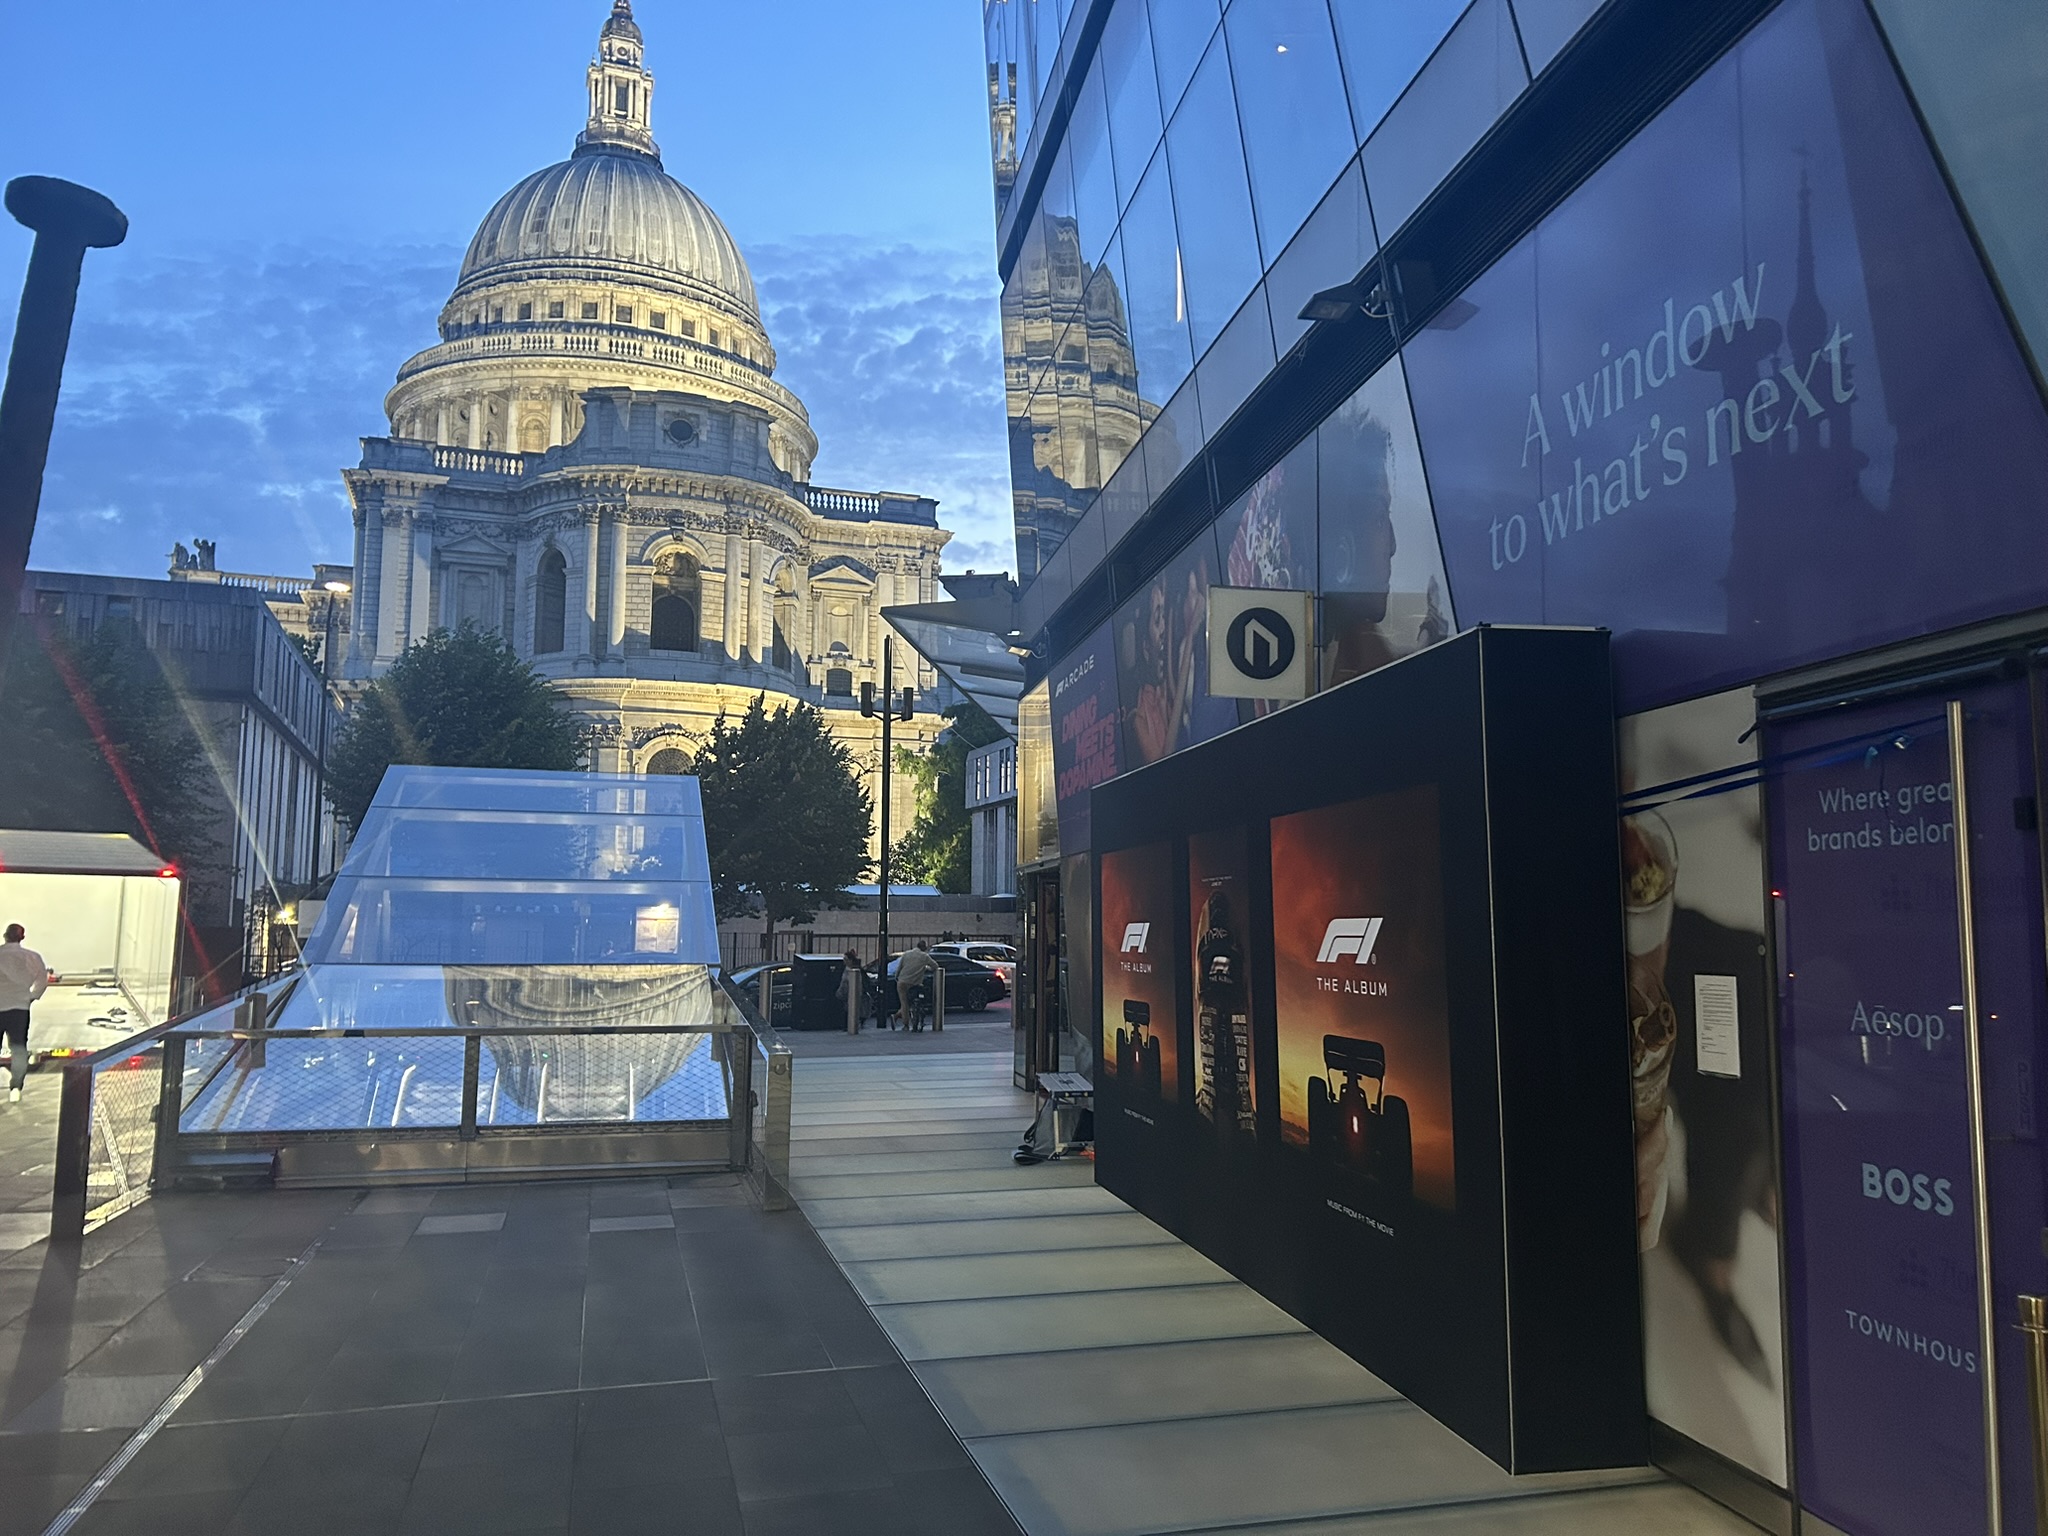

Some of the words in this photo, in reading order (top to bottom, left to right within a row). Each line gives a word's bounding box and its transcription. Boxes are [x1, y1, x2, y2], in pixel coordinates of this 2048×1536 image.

[1520, 393, 1552, 468] A
[1560, 262, 1766, 438] window
[1488, 514, 1527, 571] to
[1537, 414, 1689, 546] what's
[1706, 321, 1857, 467] next
[1063, 654, 1095, 690] ARCADE
[1062, 694, 1098, 744] DINING
[1075, 712, 1115, 764] MEETS
[1058, 743, 1118, 801] DOPAMINE
[1818, 787, 1890, 814] Where
[1897, 782, 1955, 814] grea
[1807, 821, 1882, 852] brands
[1889, 817, 1954, 846] belon
[1120, 961, 1131, 972] THE
[1132, 962, 1152, 973] ALBUM
[1316, 977, 1339, 992] THE
[1344, 979, 1388, 997] ALBUM
[772, 1000, 792, 1012] zipc
[1861, 1162, 1954, 1217] BOSS
[1845, 1309, 1977, 1374] TOWNHOUS
